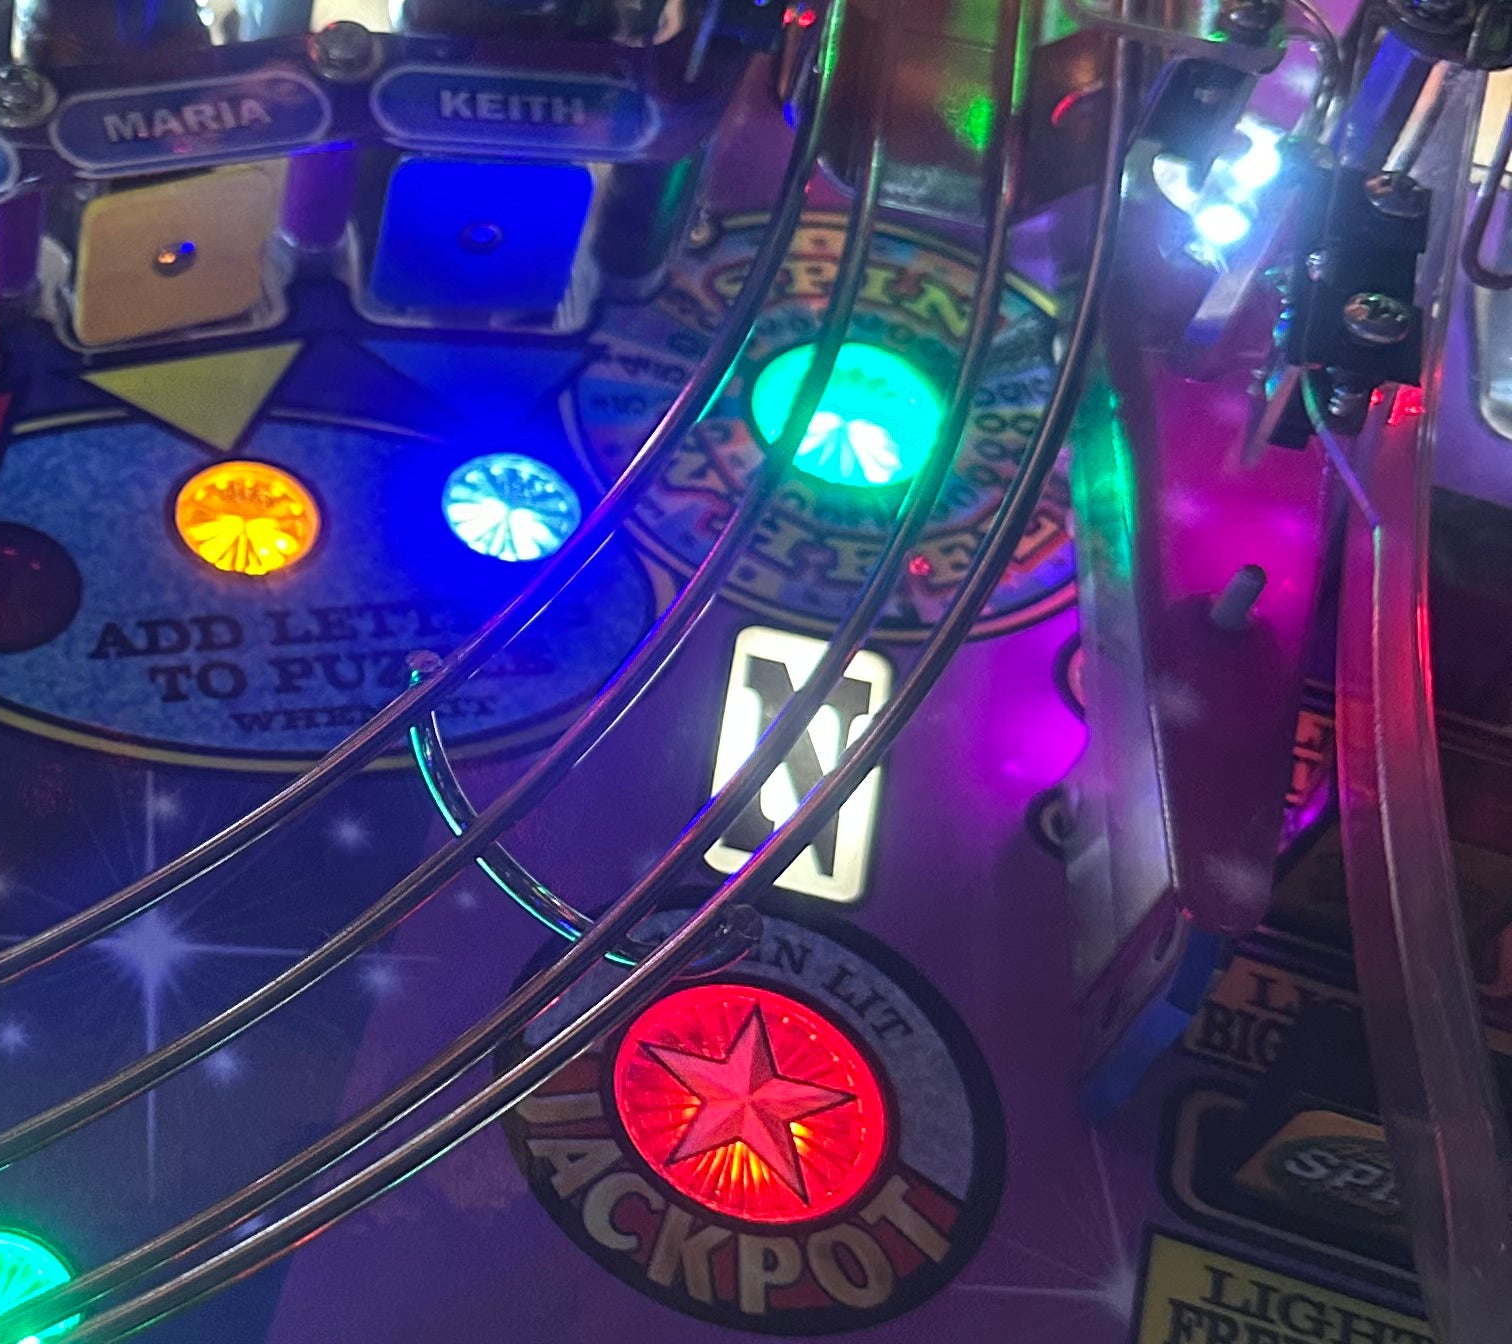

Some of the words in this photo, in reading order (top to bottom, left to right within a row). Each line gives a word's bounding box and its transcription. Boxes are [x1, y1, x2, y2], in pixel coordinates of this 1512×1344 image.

[102, 89, 274, 145] MARIA
[438, 87, 588, 128] KEITH
[92, 613, 243, 659] ADD
[148, 660, 247, 703] TO
[720, 653, 873, 879] N
[821, 964, 916, 1039] LIT
[516, 1090, 954, 1316] JACKPOT
